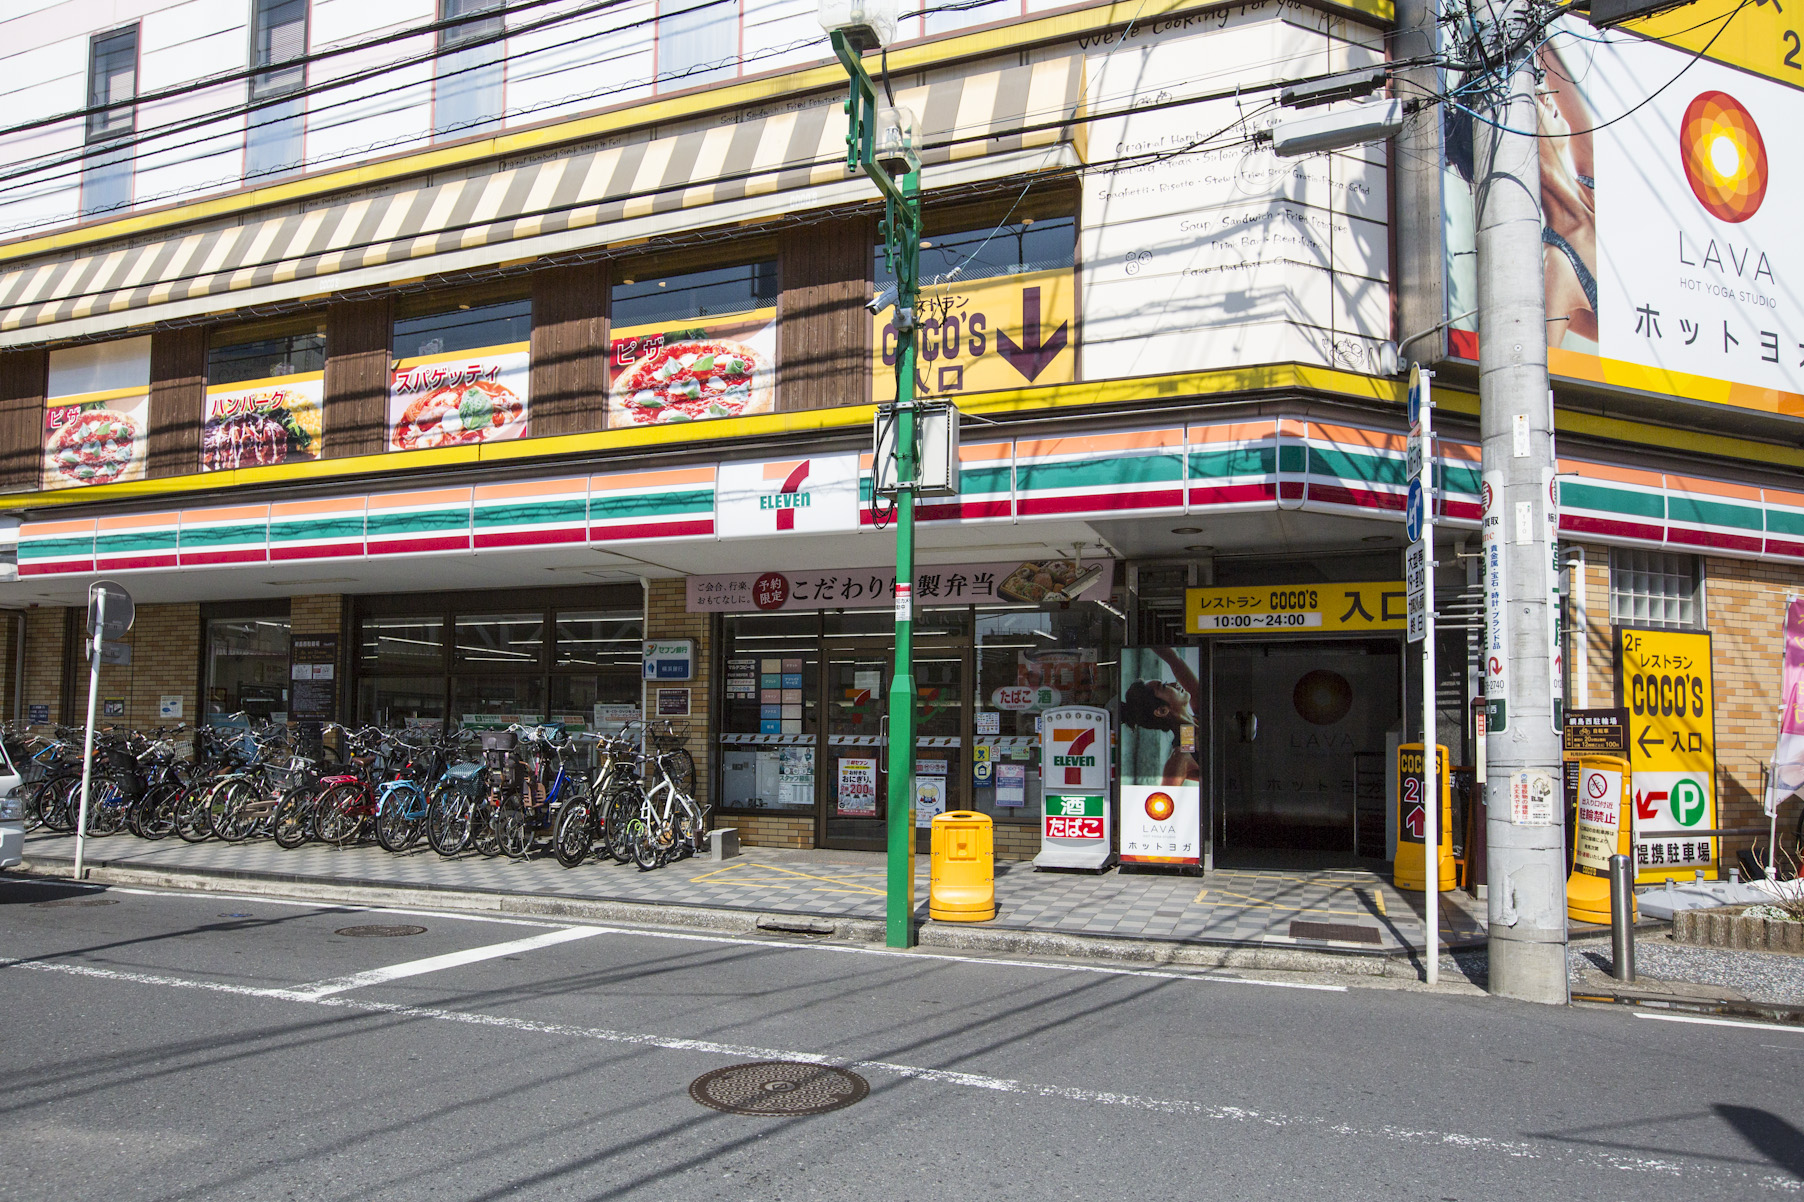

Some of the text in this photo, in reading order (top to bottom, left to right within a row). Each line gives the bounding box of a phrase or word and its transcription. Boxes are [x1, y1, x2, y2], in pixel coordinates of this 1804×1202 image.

[1153, 7, 1230, 35] Cooking
[786, 101, 806, 112] Fried
[809, 95, 842, 107] Potatoes
[608, 138, 622, 147] Foil
[1098, 186, 1149, 201] Spaghetti
[1159, 180, 1194, 193] Risotto
[1204, 174, 1231, 185] Stew
[1348, 182, 1370, 196] Salad
[1180, 219, 1211, 233] Soup
[1221, 210, 1273, 228] Sandwich
[1211, 239, 1237, 251] Drink
[1679, 230, 1775, 286] LAVA
[1680, 277, 1777, 309] HOT YOGA STUDIO
[1635, 303, 1804, 368] ホットヨ
[617, 336, 665, 367] ピザ
[394, 363, 501, 395] スパゲッティ
[211, 389, 286, 419] ハンバーグ
[49, 407, 82, 430] ピザ
[758, 577, 783, 591] 予約
[760, 590, 784, 605] 限定
[1201, 589, 1318, 611] レストラン COCO'S
[1339, 590, 1407, 623] 入口
[659, 646, 688, 654] セブン銀行
[1624, 633, 1642, 652] 2F
[1641, 653, 1693, 670] レストラン
[1000, 689, 1032, 704] たばこ
[1037, 689, 1052, 704] 酒
[1632, 673, 1704, 718] COCO'S
[1290, 733, 1355, 748] LAVA
[1670, 731, 1702, 753] 入口
[1060, 796, 1087, 816] 酒
[1677, 783, 1700, 824] P
[1580, 807, 1616, 825] 駐輪禁止
[1048, 818, 1100, 838] たばこ
[1142, 824, 1176, 834] LAVA
[1129, 841, 1192, 852] ホットヨガ
[1637, 842, 1711, 865] 提携駐車場
